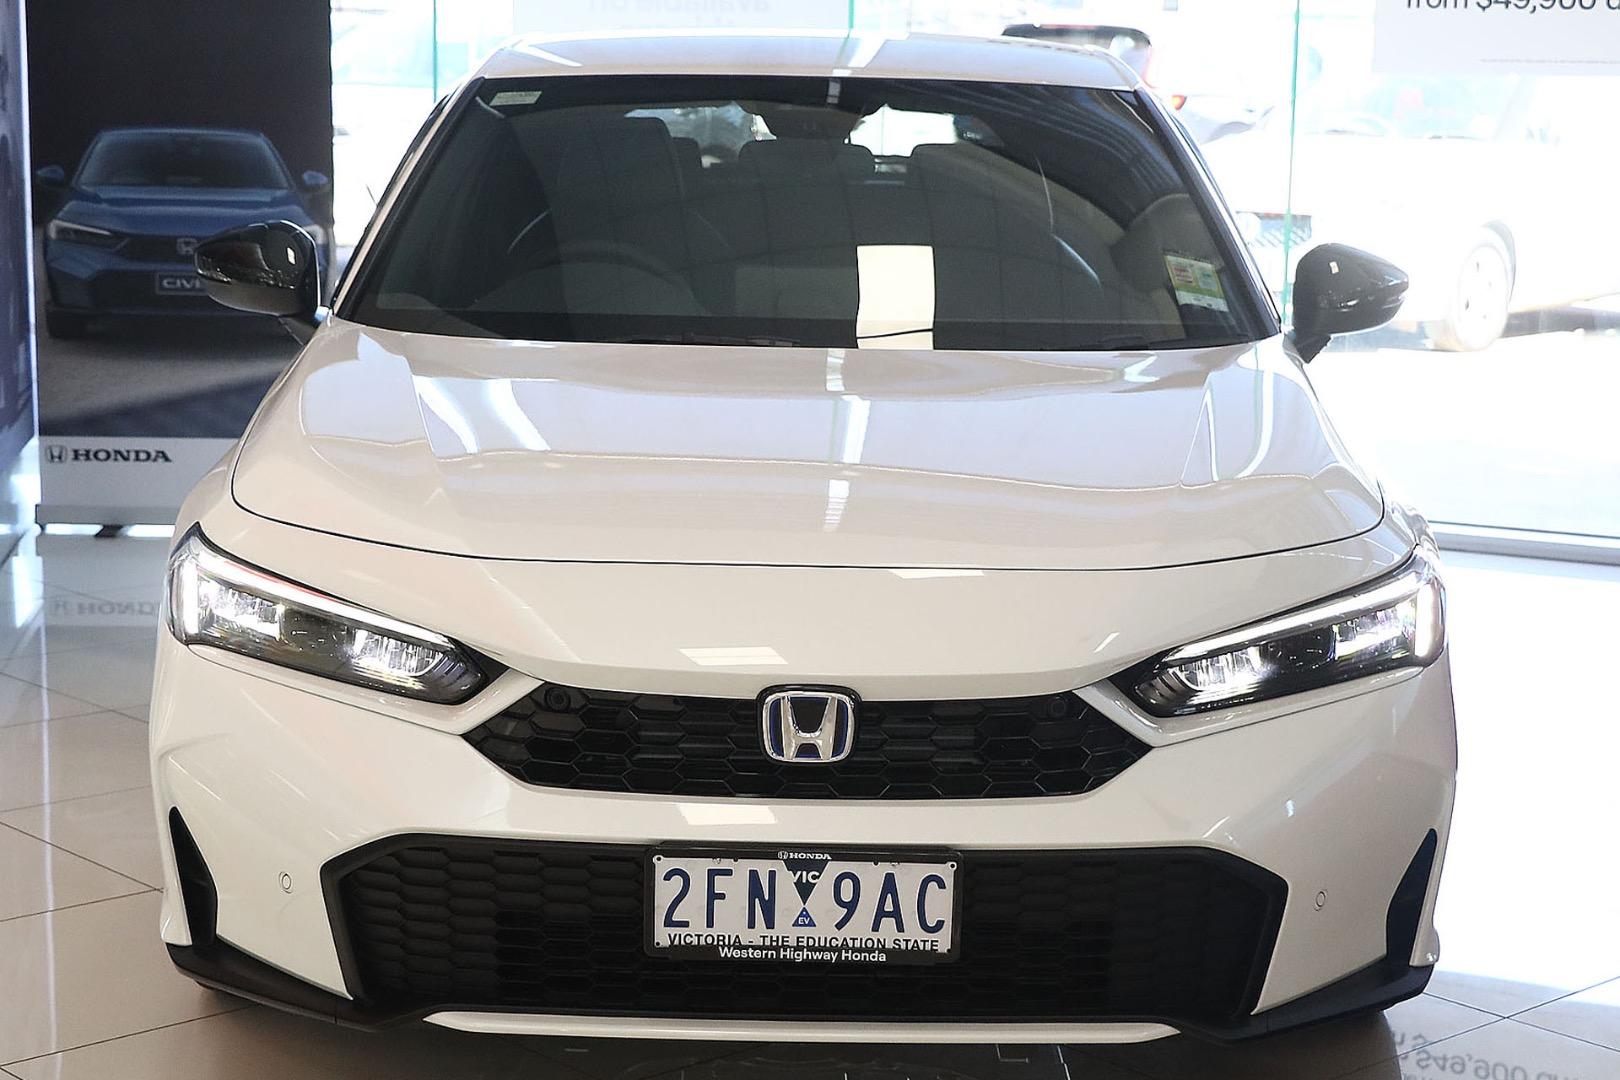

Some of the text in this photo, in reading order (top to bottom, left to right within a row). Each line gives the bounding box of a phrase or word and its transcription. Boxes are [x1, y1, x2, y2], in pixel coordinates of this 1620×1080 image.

[162, 278, 201, 289] CIVI
[72, 448, 172, 463] HONDA
[789, 852, 832, 860] HONDA
[788, 870, 820, 884] VIC
[798, 916, 811, 926] EV
[667, 933, 743, 947] VICTORIA
[760, 934, 791, 947] THE
[796, 935, 887, 949] EDUCATION
[893, 938, 939, 951] STATE
[719, 946, 887, 963] Western Highway Honda
